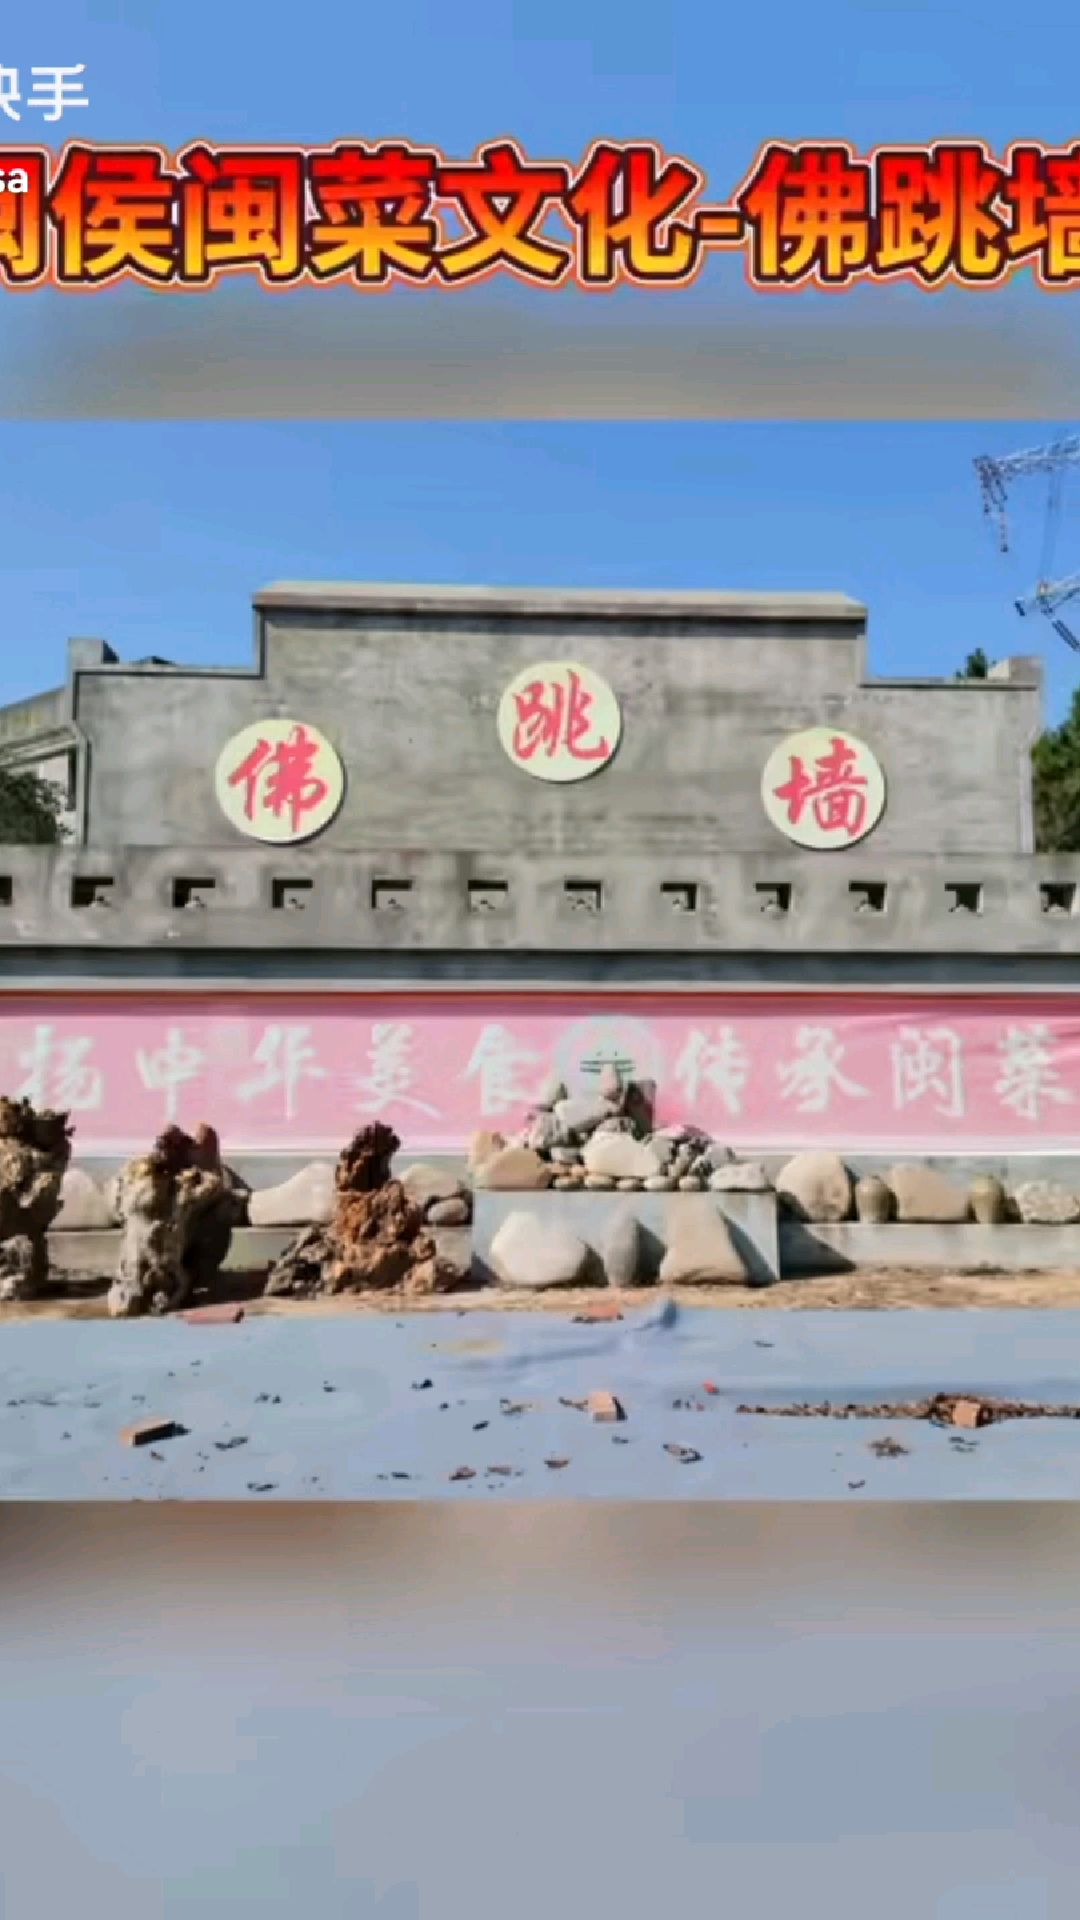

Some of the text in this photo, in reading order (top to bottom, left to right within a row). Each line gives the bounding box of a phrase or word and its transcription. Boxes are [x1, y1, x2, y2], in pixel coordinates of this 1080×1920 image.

[226, 668, 870, 838] 佛 跳 墙
[674, 1022, 1076, 1122] 传承闽菜
